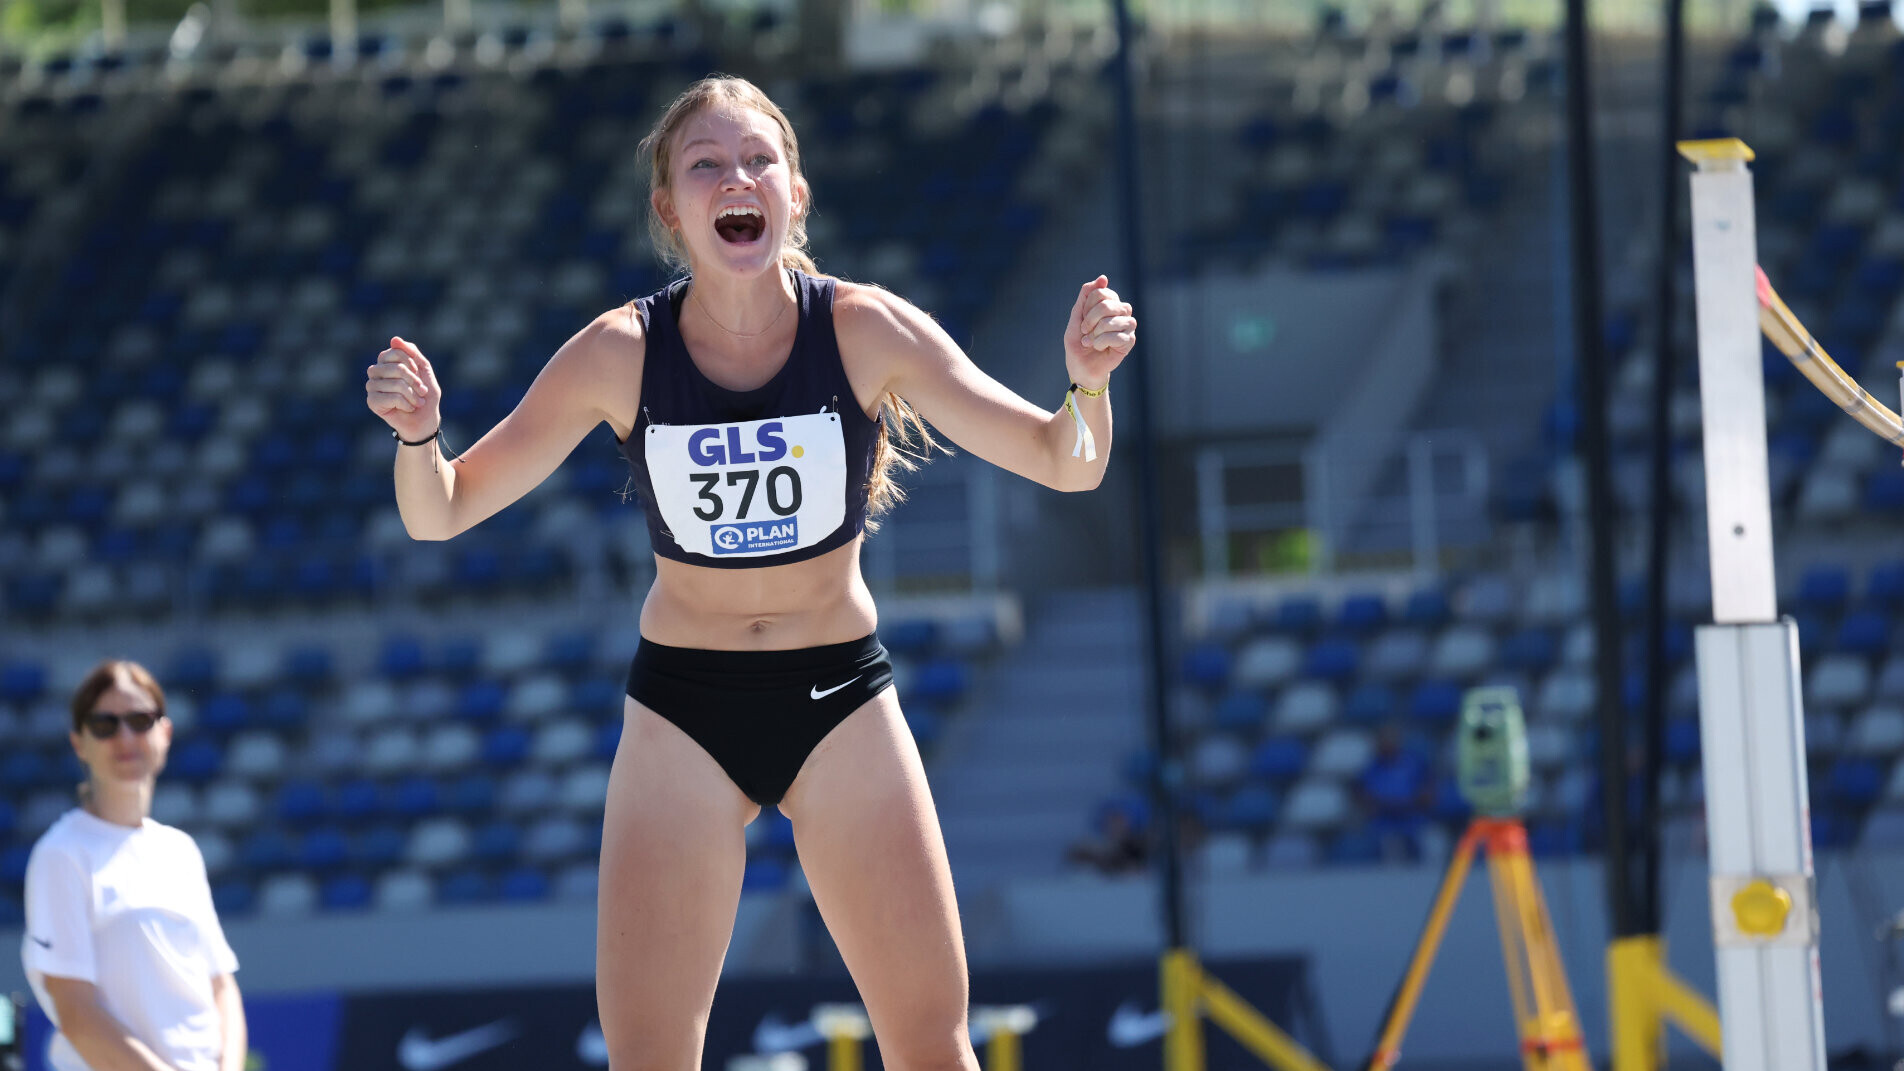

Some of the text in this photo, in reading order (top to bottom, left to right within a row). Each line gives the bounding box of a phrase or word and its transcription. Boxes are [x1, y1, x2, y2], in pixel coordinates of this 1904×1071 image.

[689, 465, 803, 522] 370
[746, 523, 795, 541] PLAN
[747, 538, 795, 549] INTERNATIONAL
